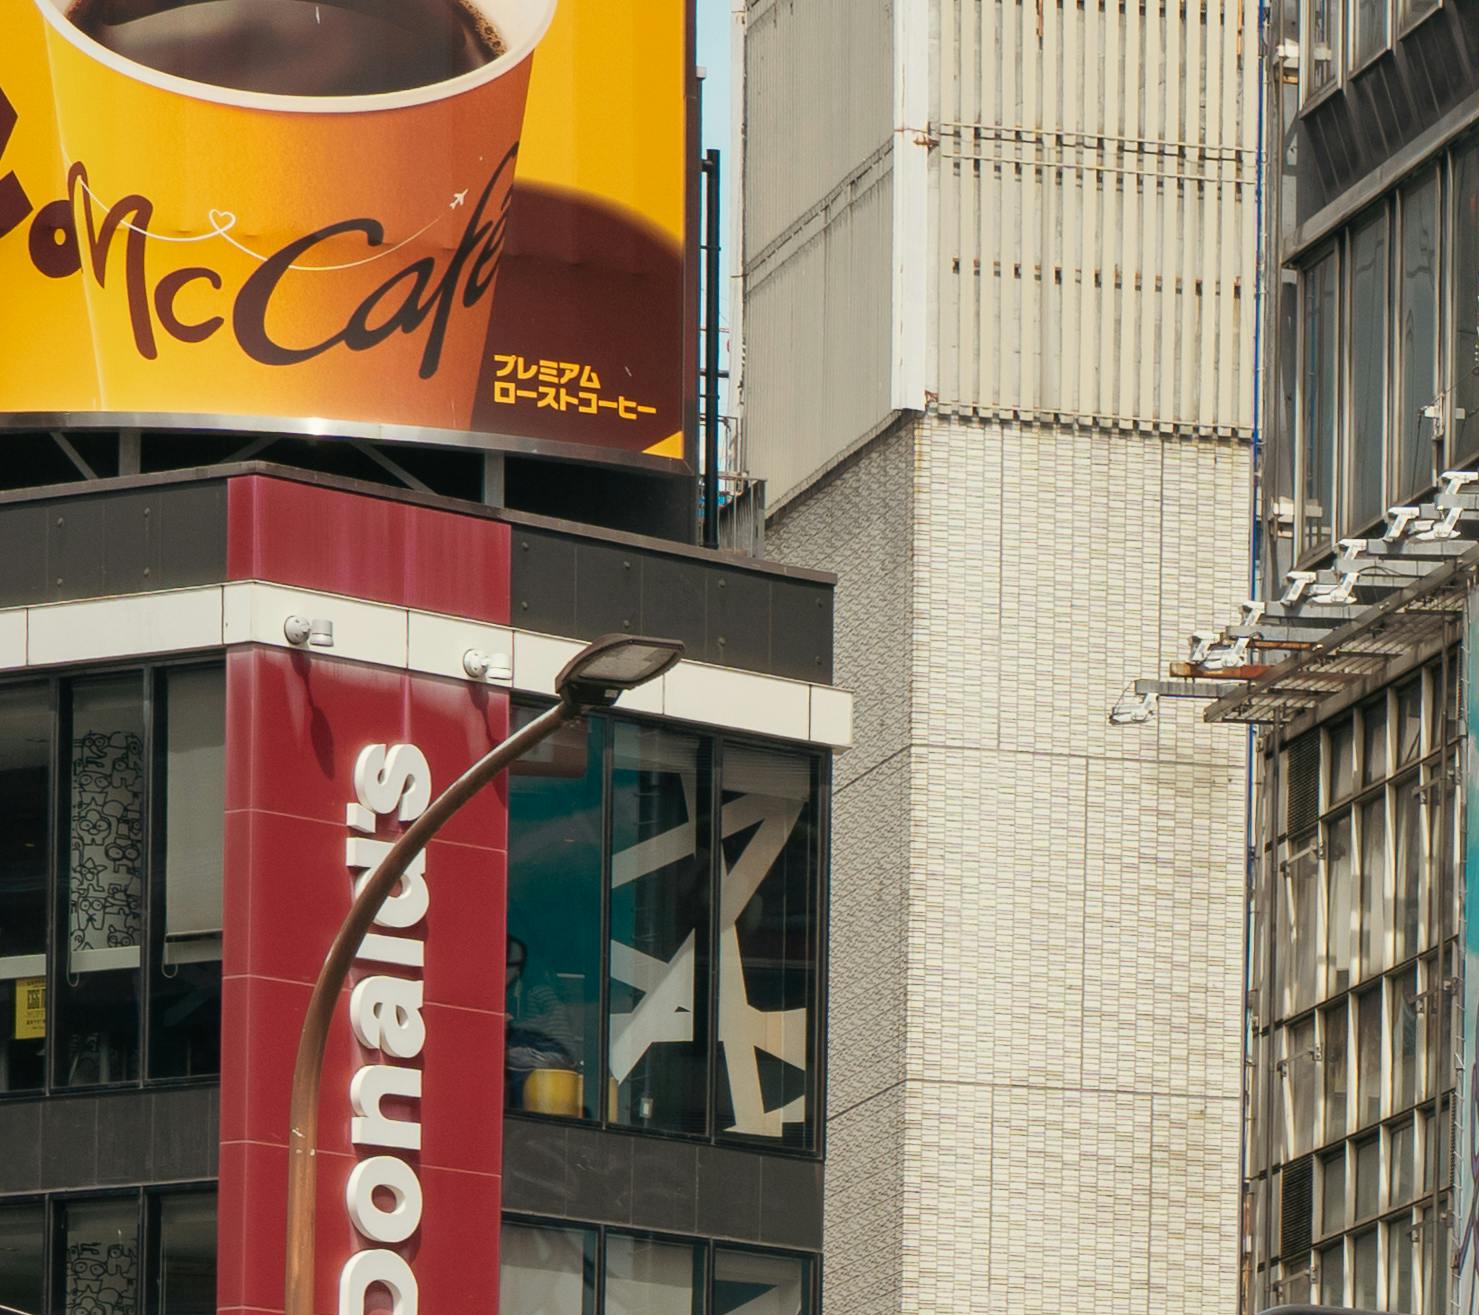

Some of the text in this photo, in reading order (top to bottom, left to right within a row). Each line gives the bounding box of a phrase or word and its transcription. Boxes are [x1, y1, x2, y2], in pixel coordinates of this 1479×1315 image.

[494, 354, 602, 390] プレミアム
[494, 384, 657, 421] ローストコーヒー
